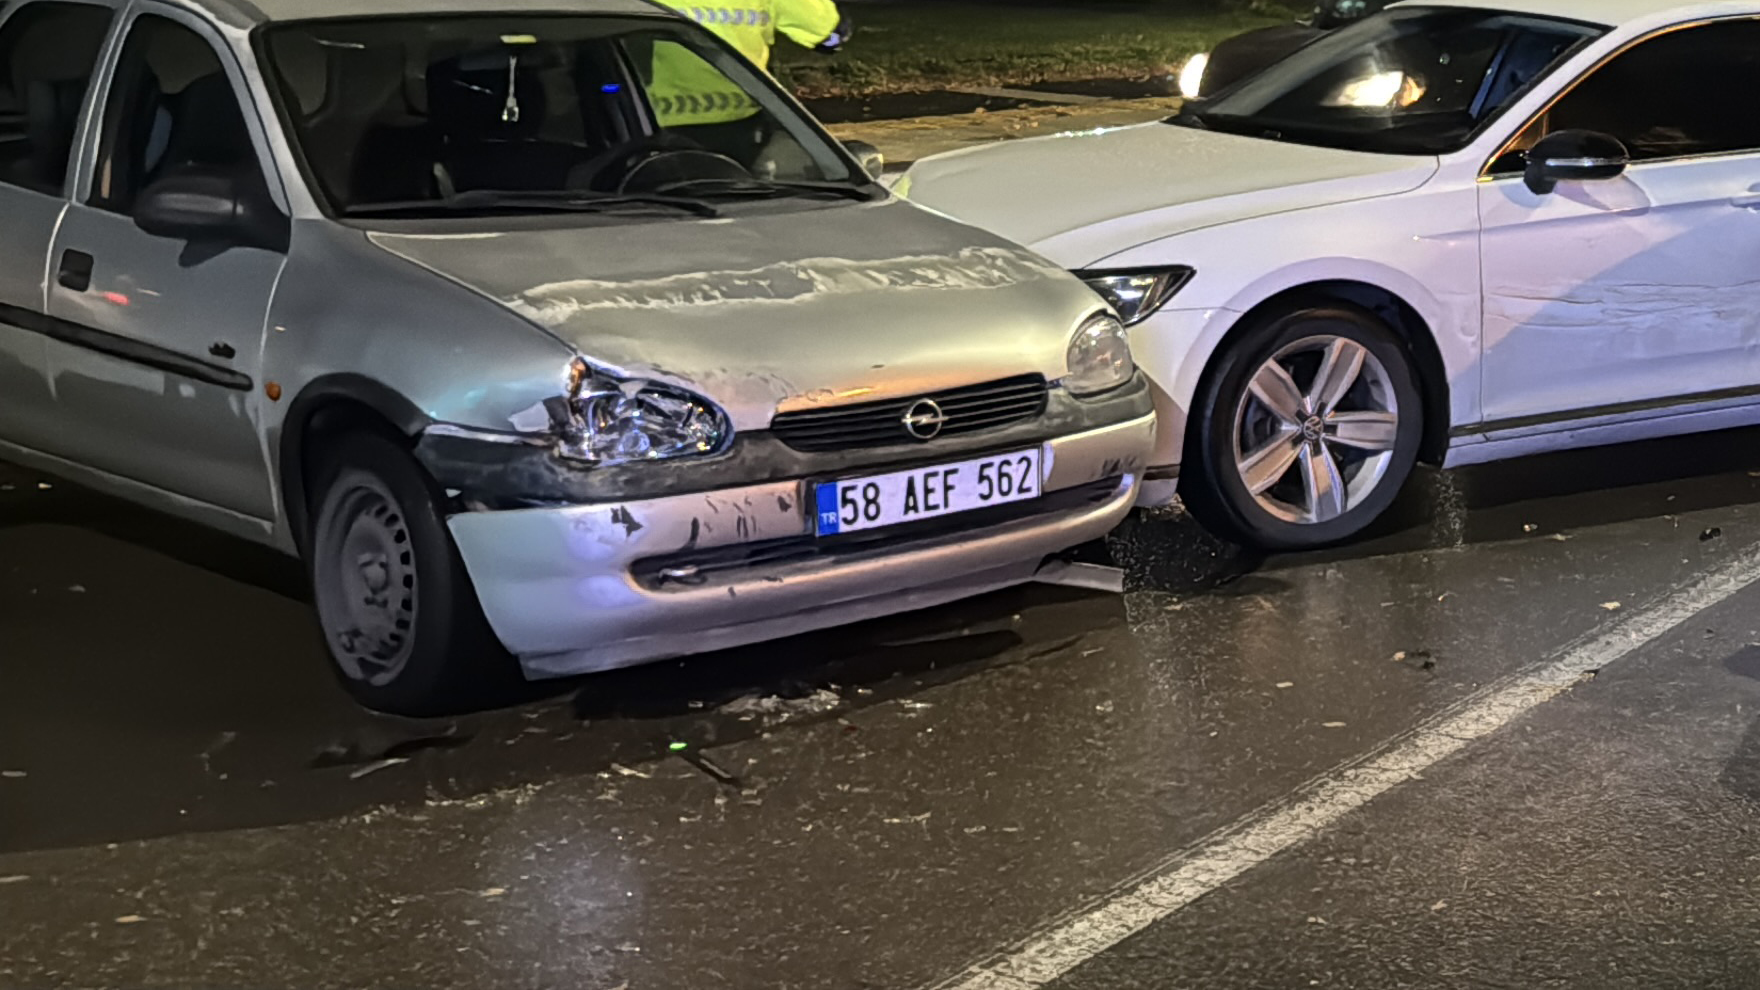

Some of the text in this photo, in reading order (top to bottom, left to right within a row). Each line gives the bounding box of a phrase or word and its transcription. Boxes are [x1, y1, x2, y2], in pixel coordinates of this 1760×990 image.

[840, 456, 1033, 526] 58 AEF 562
[820, 512, 837, 525] TR
